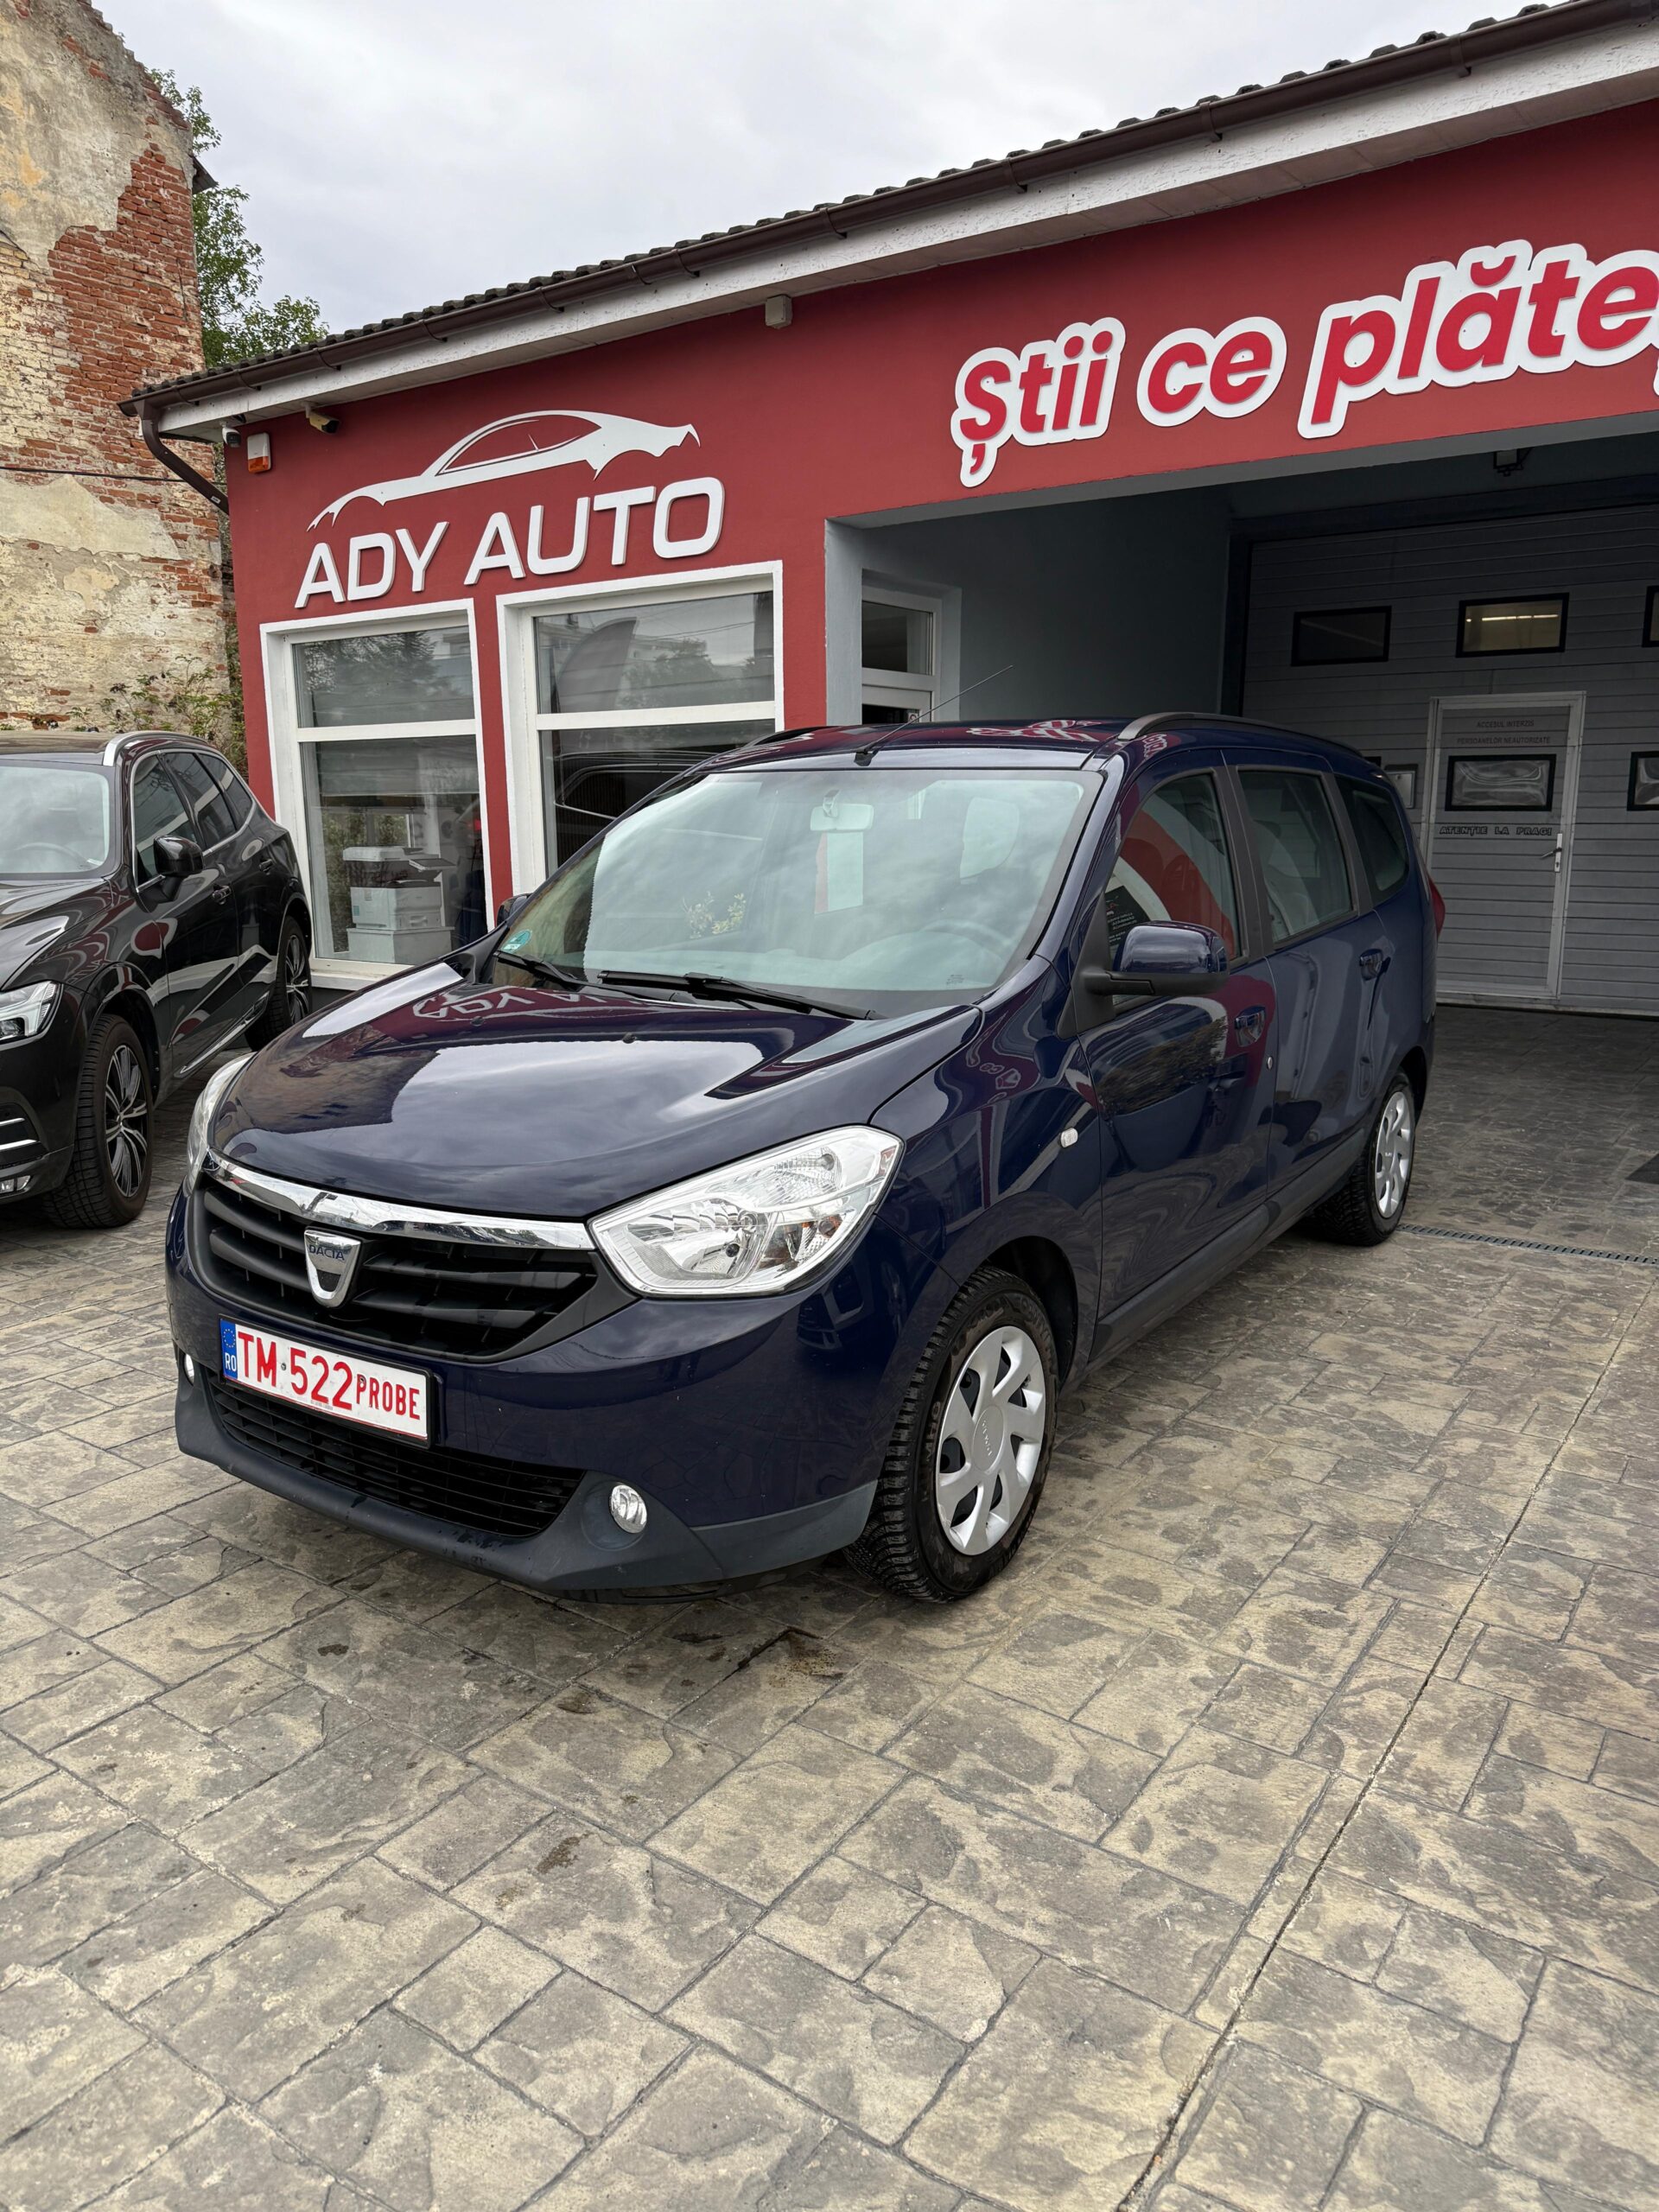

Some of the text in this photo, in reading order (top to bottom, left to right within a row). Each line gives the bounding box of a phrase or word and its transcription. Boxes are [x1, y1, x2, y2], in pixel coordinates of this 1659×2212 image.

[959, 254, 1659, 474] Știi ce plăte
[295, 476, 725, 609] ADY AUTO
[1476, 719, 1535, 728] ACCESUL INTERZIS
[1494, 826, 1510, 836] LA
[1516, 827, 1553, 836] PRAG!
[308, 1243, 346, 1262] DACIA
[225, 1352, 237, 1372] RO
[237, 1331, 421, 1421] TM 522 PROBE
